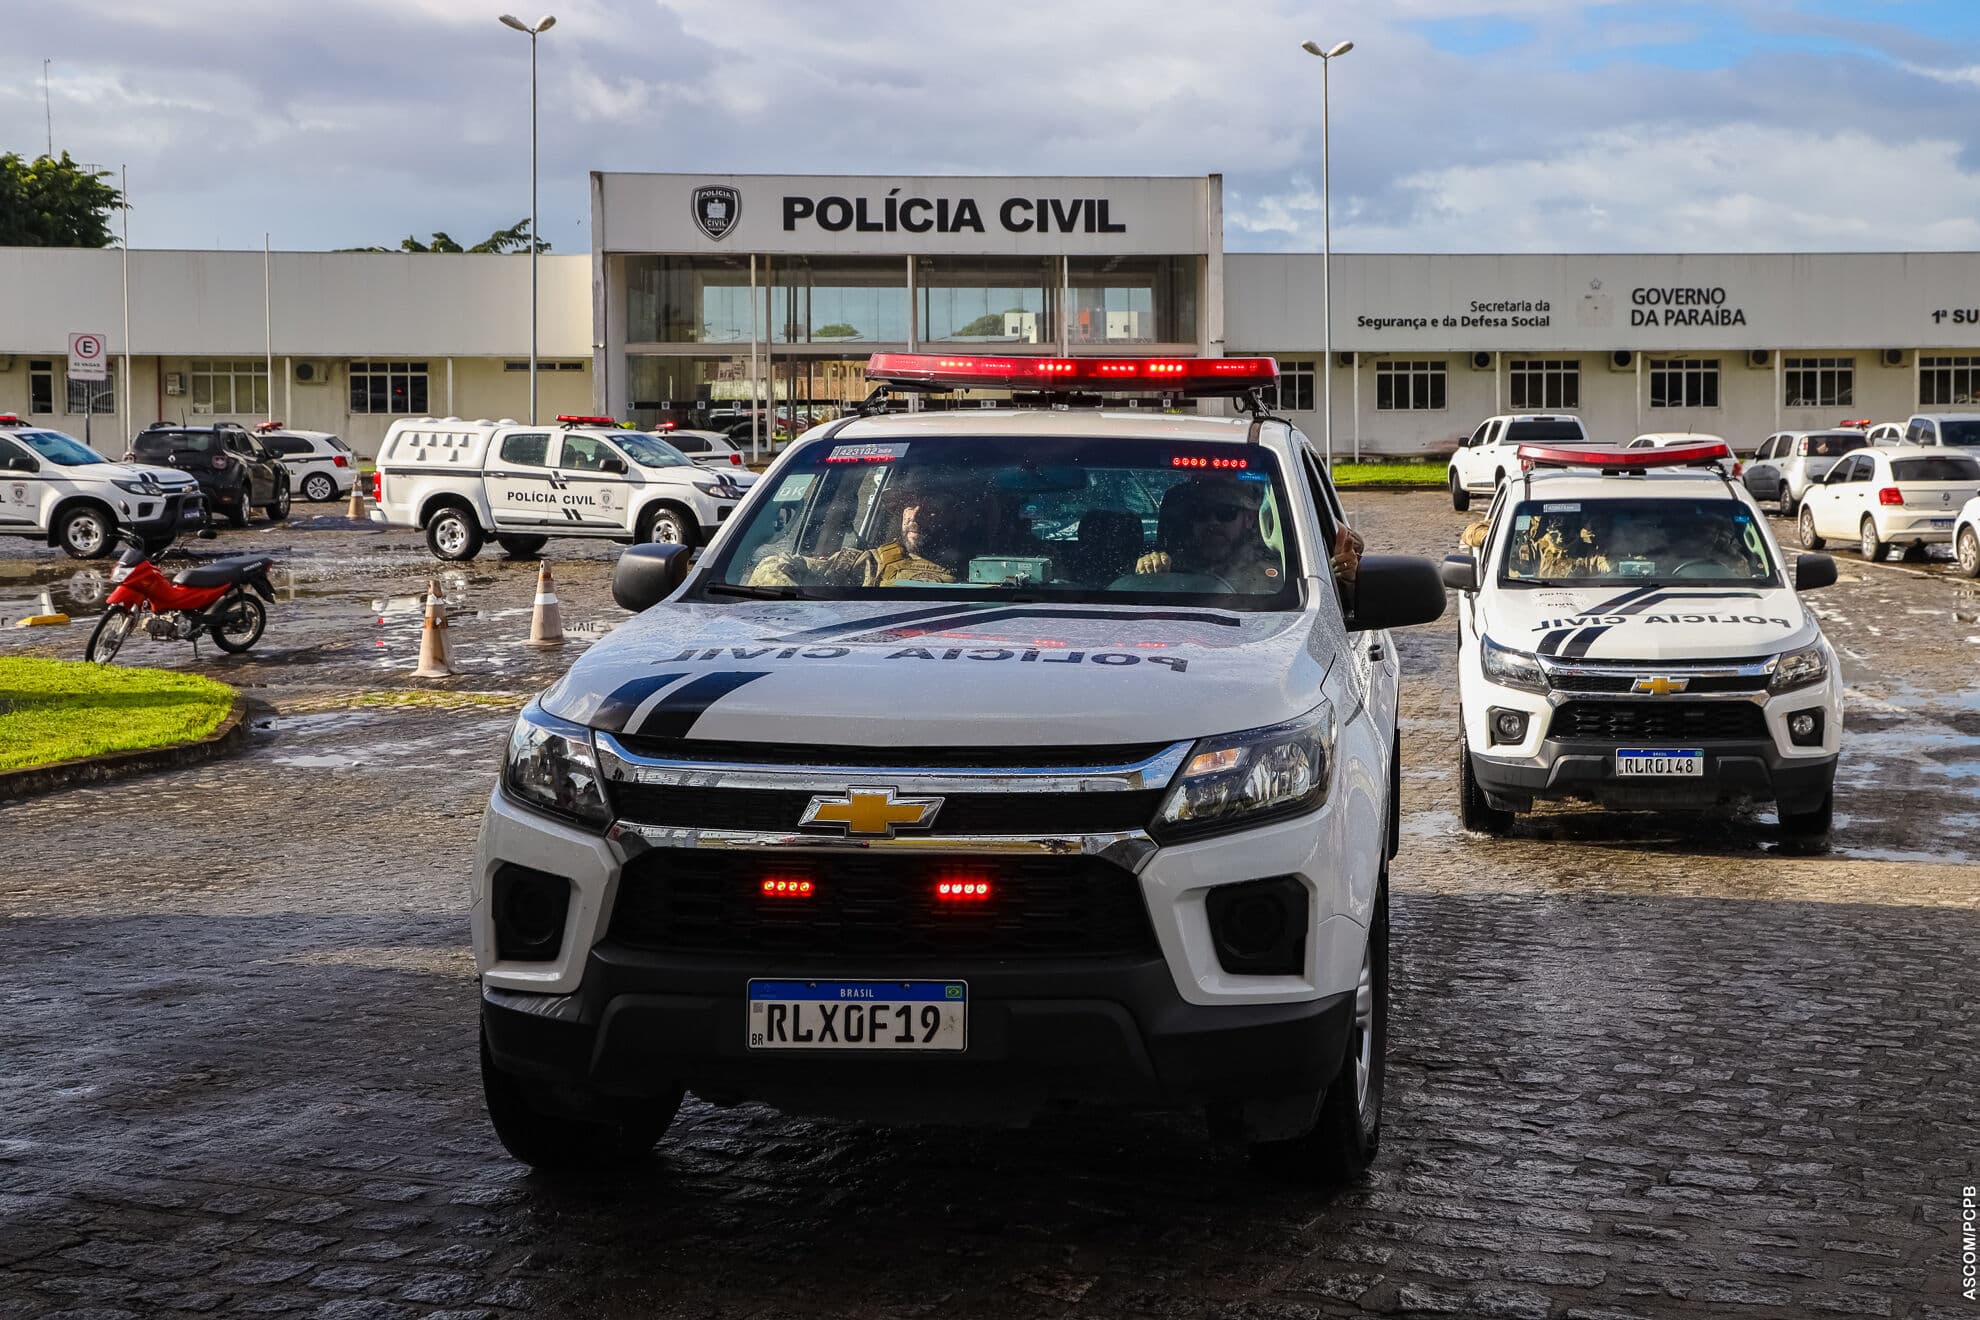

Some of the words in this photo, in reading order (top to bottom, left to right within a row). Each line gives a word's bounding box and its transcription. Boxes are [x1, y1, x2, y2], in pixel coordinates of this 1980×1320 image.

[783, 188, 985, 233] POLÍCIA
[1000, 198, 1126, 233] CIVIL
[706, 219, 727, 227] CIVIL
[1632, 287, 1726, 305] GOVERNO
[1470, 301, 1532, 312] Secretaria
[1535, 301, 1551, 312] da
[1357, 316, 1427, 330] Segurança
[1431, 317, 1439, 327] e
[1442, 315, 1458, 327] da
[1461, 316, 1508, 327] Defesa
[1511, 316, 1550, 327] Social
[1631, 309, 1659, 326] DA
[1664, 305, 1747, 326] PARAÍBA
[1952, 308, 1979, 324] SU
[83, 340, 93, 354] E
[507, 491, 557, 504] POLÍCIA
[562, 495, 596, 505] CIVIL
[840, 988, 874, 998] BRASIL
[751, 1033, 764, 1046] BR
